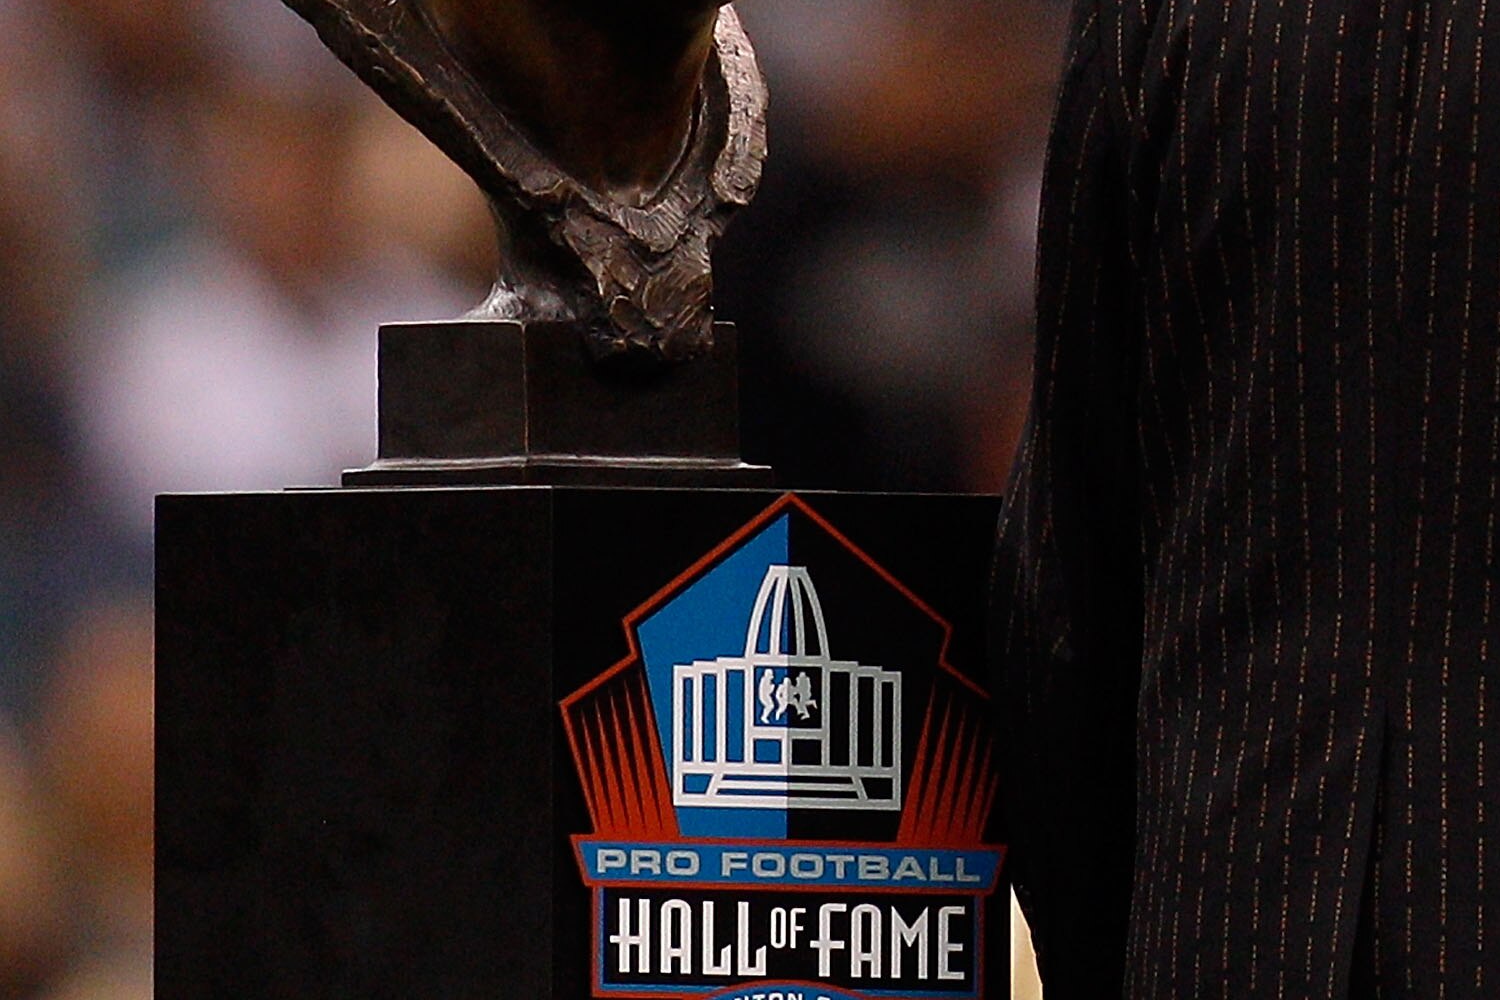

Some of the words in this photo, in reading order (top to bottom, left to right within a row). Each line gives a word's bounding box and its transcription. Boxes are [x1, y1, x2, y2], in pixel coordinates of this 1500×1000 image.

[597, 849, 700, 876] PRO
[721, 852, 981, 882] FOOTBALL
[609, 898, 767, 976] HALL
[770, 906, 807, 949] OF
[809, 903, 966, 980] FAME
